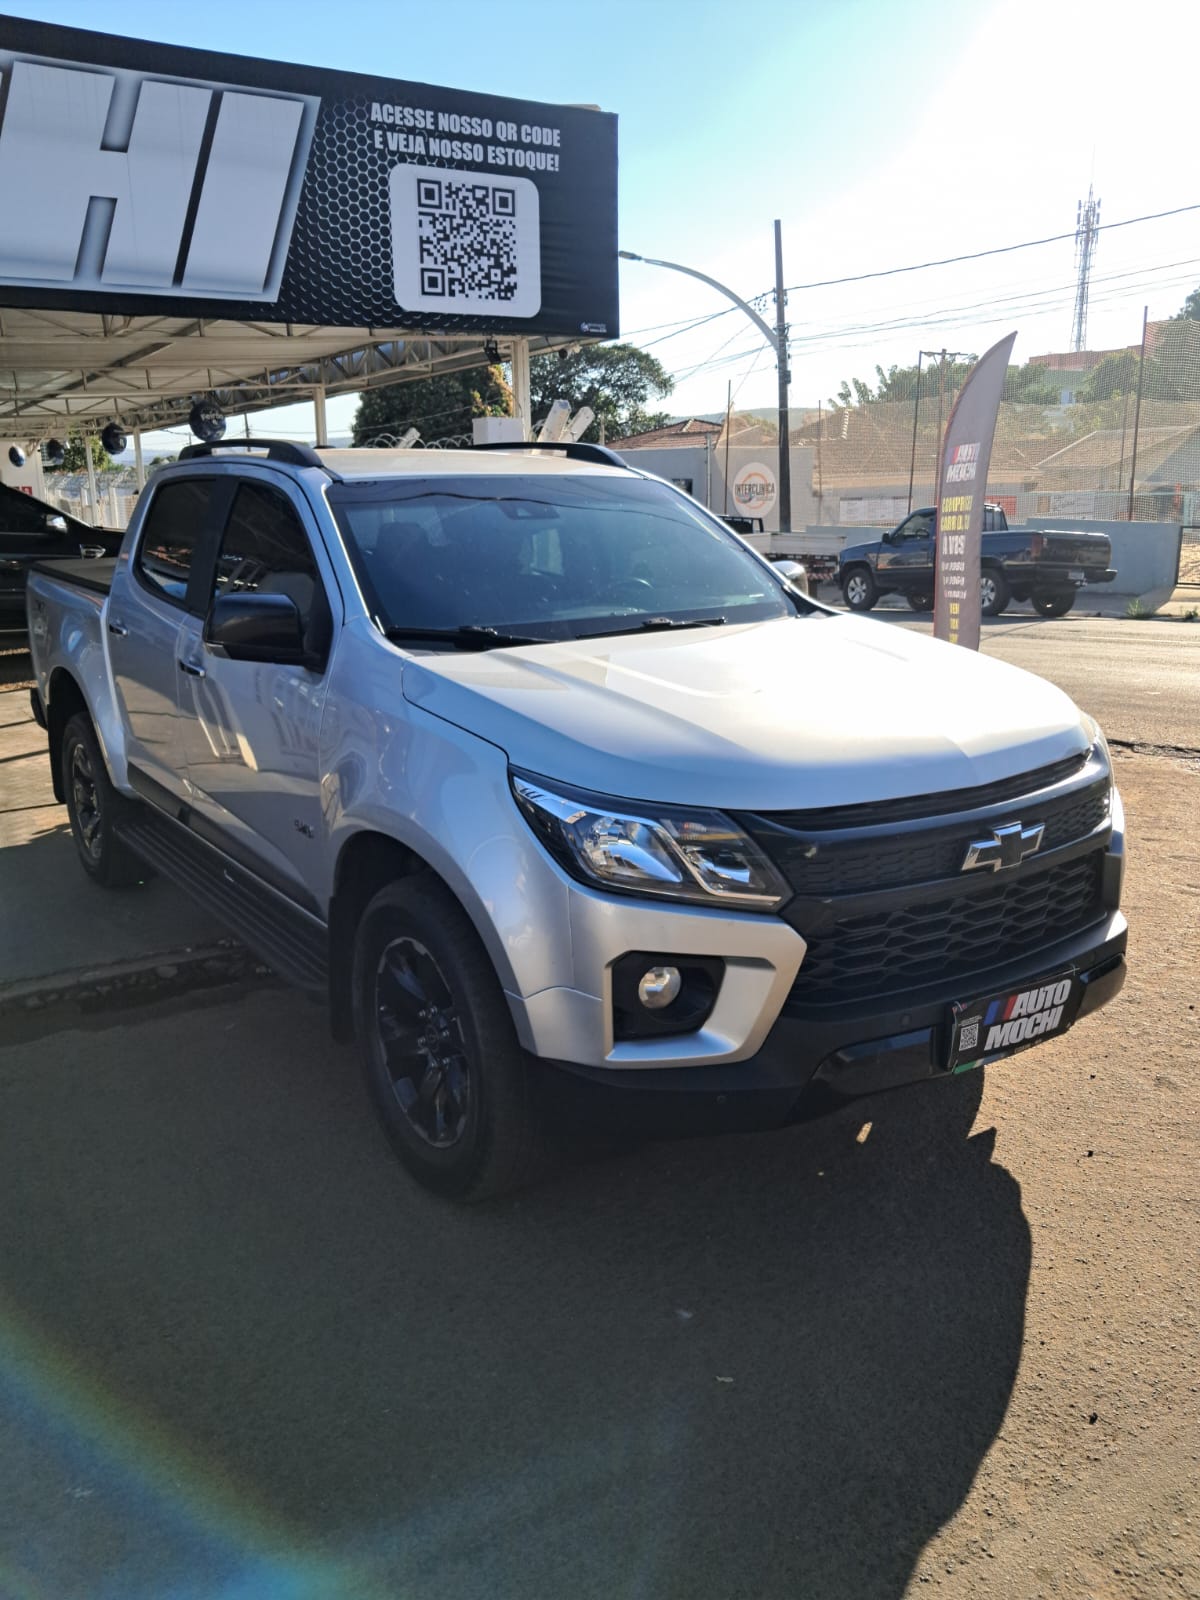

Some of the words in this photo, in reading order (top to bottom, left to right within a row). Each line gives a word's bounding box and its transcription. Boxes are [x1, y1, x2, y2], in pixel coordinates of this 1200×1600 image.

[371, 102, 434, 130] ACESSE
[438, 112, 492, 138] NOSSO
[496, 121, 518, 142] QR
[521, 125, 561, 147] CODE
[374, 130, 384, 149] E
[386, 131, 426, 155] VEJA
[429, 138, 484, 162] NOSSO
[487, 146, 560, 172] ESTOQUE!
[0, 55, 316, 299] HI
[1009, 979, 1072, 1020] AUTO
[983, 1005, 1065, 1051] MOCHI
